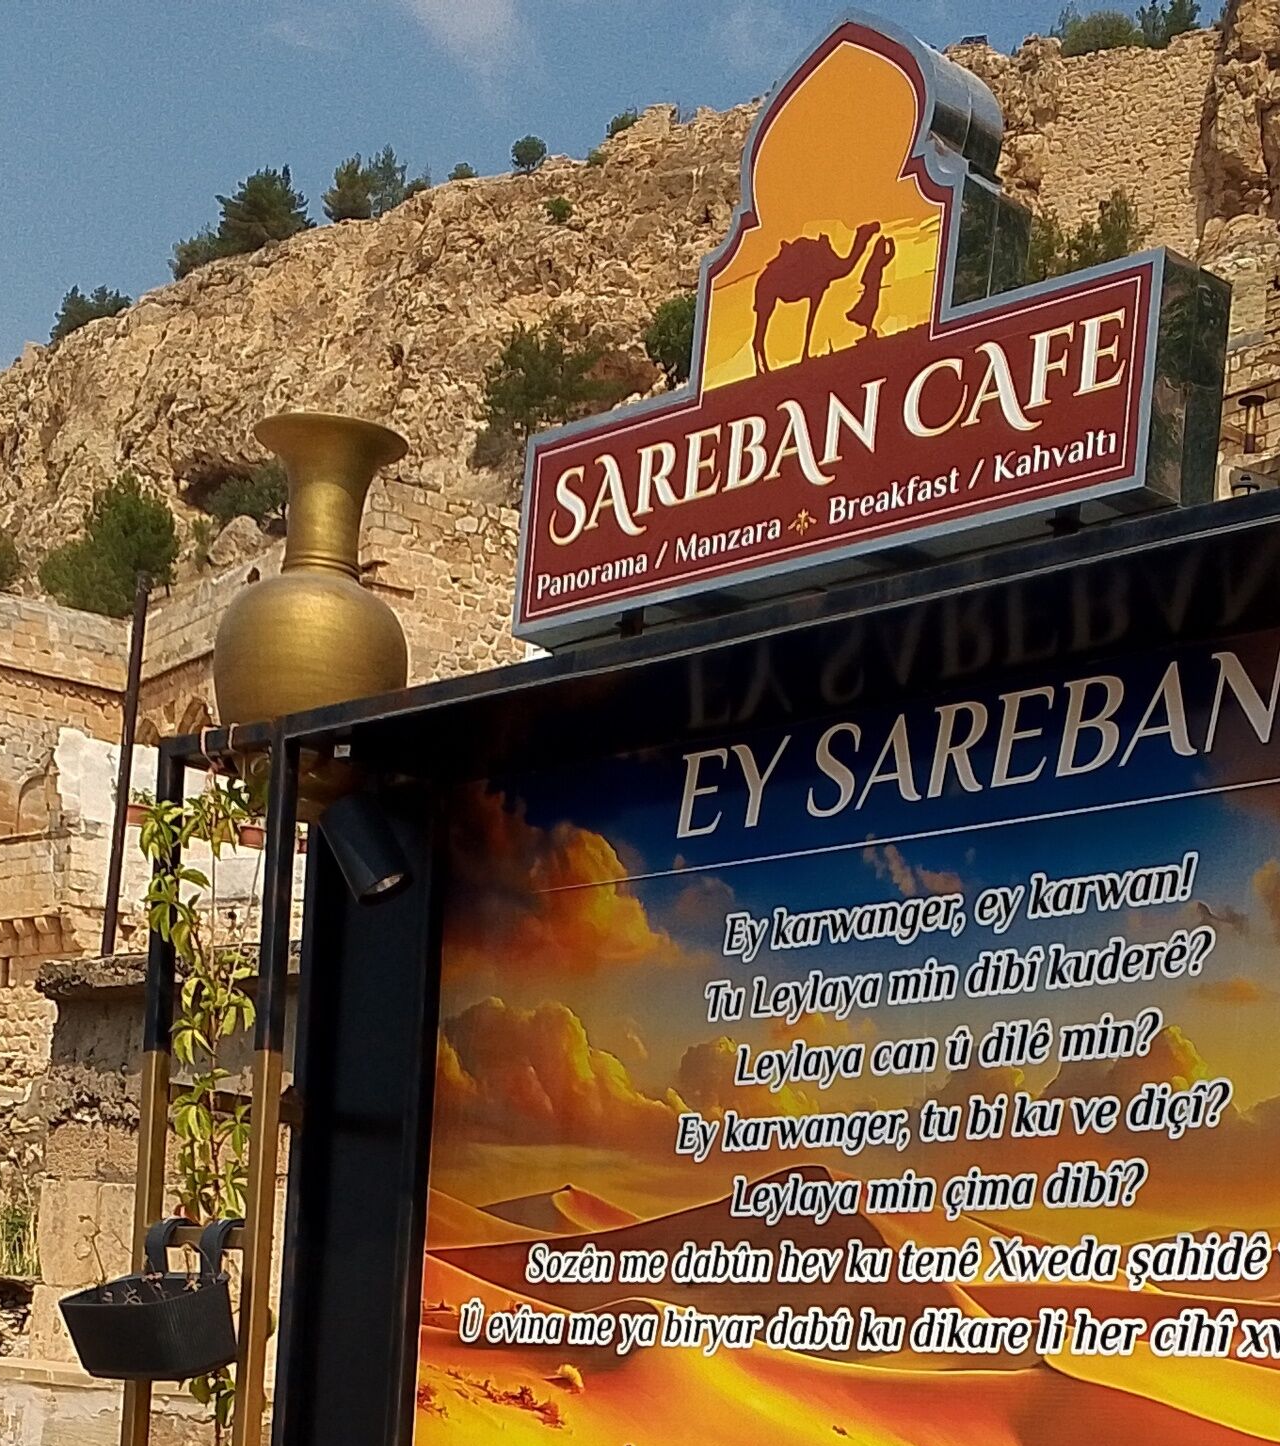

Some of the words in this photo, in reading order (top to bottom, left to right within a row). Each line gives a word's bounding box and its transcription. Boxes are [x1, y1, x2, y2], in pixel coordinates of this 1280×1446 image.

[549, 377, 886, 547] SAREBAN
[902, 308, 1127, 438] CAFE
[536, 553, 648, 600] Panorama
[655, 541, 668, 569] /
[675, 518, 781, 564] Manzara
[829, 467, 960, 524] Breakfast
[967, 458, 985, 490] /
[994, 429, 1117, 483] Kahvaltı
[676, 734, 791, 839] EY
[725, 913, 767, 961] Ey
[772, 894, 964, 943] karwanger,
[977, 888, 1022, 931] ey
[1029, 853, 1197, 917] karwan!
[707, 982, 743, 1020] Tu
[753, 973, 880, 1022] Leylaya
[889, 959, 957, 1004] min
[967, 948, 1042, 995] dibî
[1047, 928, 1214, 988] kuderê?
[736, 1041, 862, 1090] Leylaya
[873, 1039, 937, 1075] can
[947, 1027, 970, 1068] û
[981, 1020, 1051, 1064] dilê
[1061, 1009, 1160, 1059] min?
[678, 1115, 717, 1160] Ey
[724, 1110, 909, 1154] karwanger,
[922, 1101, 959, 1140] tu
[968, 1094, 1006, 1138] bi
[1013, 1093, 1062, 1135] ku
[1073, 1097, 1118, 1133] ve
[1128, 1079, 1231, 1137] diçî?
[733, 1175, 860, 1223] Leylaya
[868, 1170, 935, 1212] min
[944, 1168, 1036, 1219] çima
[1045, 1159, 1147, 1206] dibî?
[528, 1244, 613, 1281] Sozên
[621, 1250, 666, 1281] me
[674, 1241, 771, 1282] dabûn
[779, 1241, 842, 1281] hev
[847, 1240, 890, 1281] ku
[900, 1239, 980, 1280] tenê
[986, 1237, 1119, 1280] Xweda
[1128, 1232, 1270, 1289] şahidê
[461, 1299, 482, 1341] Û
[487, 1305, 562, 1342] evîna
[570, 1313, 613, 1343] me
[619, 1314, 659, 1353] ya
[663, 1309, 761, 1354] biryar
[768, 1308, 852, 1348] dabû
[859, 1308, 904, 1349] ku
[912, 1309, 1030, 1352] dikare
[1038, 1310, 1066, 1353] li
[1073, 1310, 1144, 1353] her
[1153, 1310, 1236, 1354] cihî
